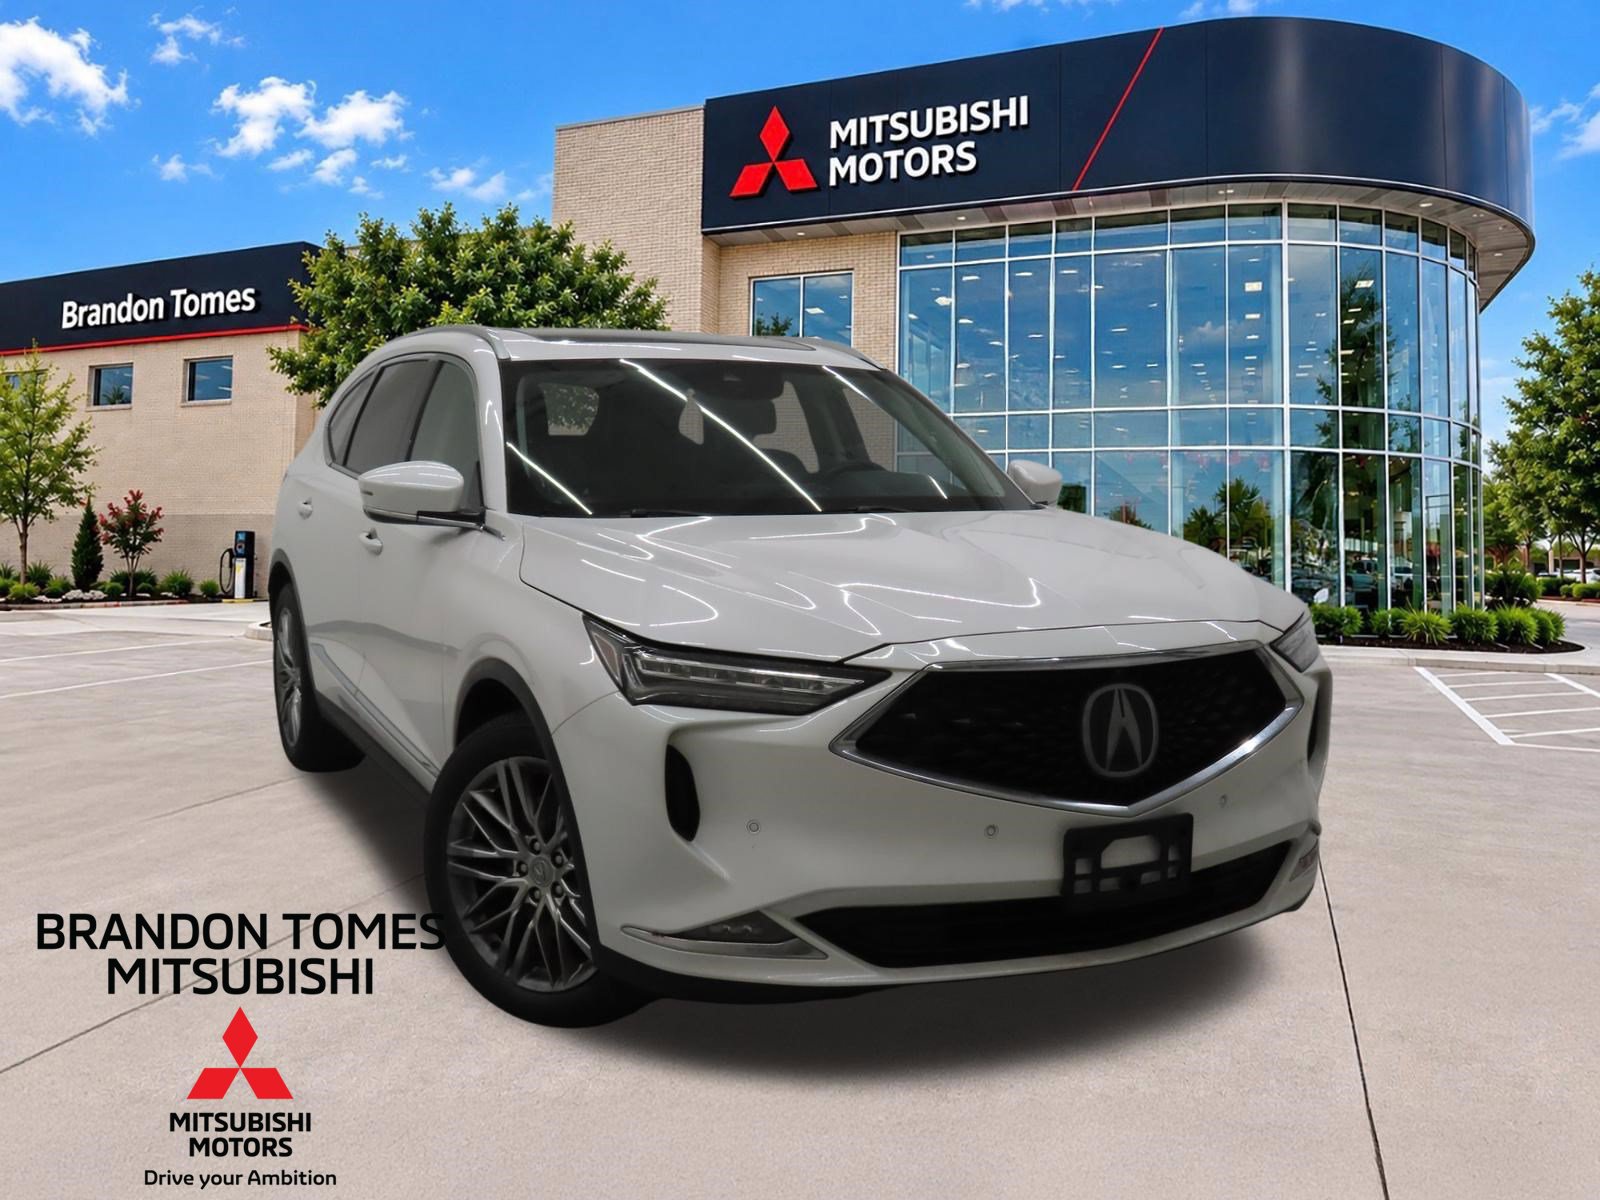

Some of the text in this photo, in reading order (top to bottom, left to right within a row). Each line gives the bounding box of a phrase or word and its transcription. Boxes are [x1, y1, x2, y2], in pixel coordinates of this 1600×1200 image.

[830, 95, 1029, 149] MITSUBISHI
[829, 141, 977, 186] MOTORS
[62, 288, 256, 329] Brandon Tomes
